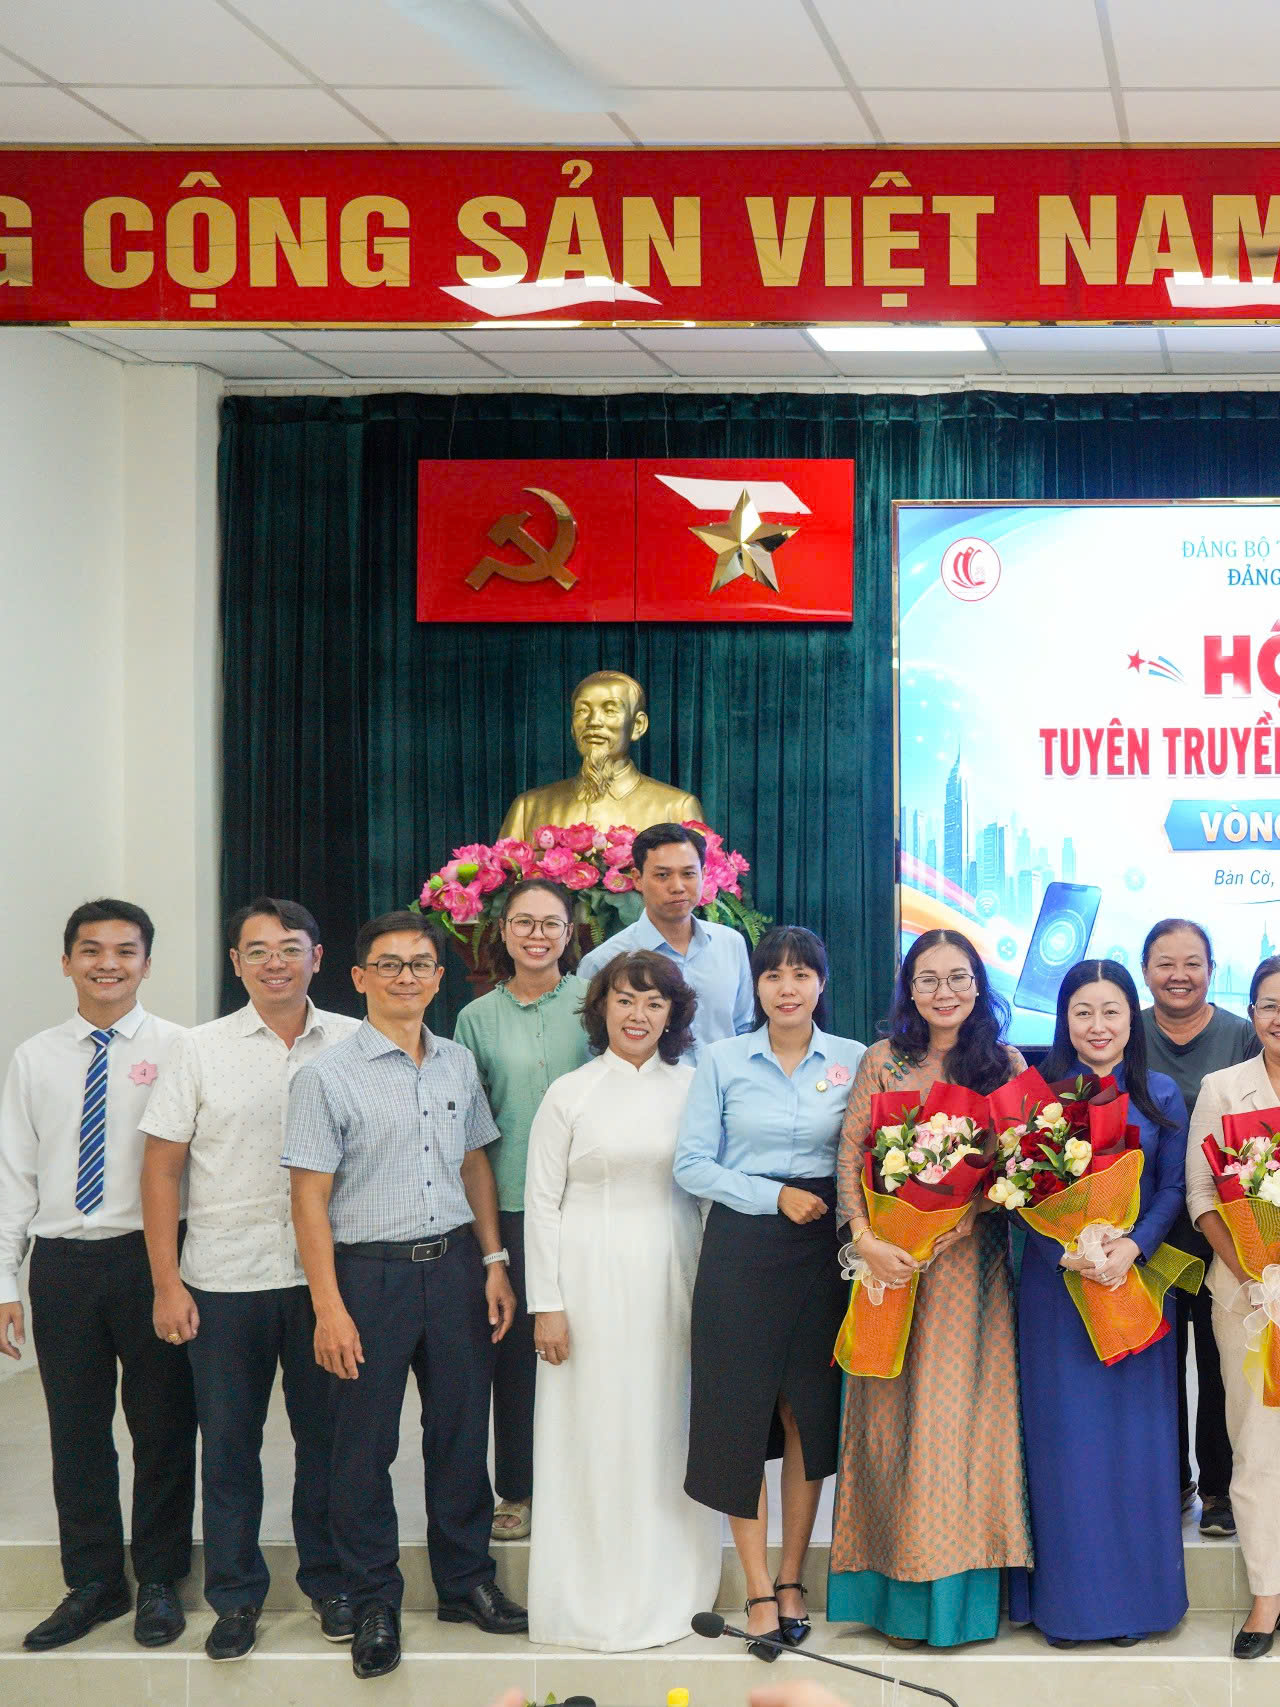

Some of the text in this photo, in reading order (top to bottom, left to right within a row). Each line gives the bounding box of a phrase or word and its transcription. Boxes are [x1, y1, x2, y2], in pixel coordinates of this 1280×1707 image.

[83, 171, 410, 308] CỘNG
[455, 159, 702, 288] SẢN
[745, 171, 995, 307] VIỆT
[1181, 536, 1237, 558] ĐẢNG
[1244, 536, 1270, 561] BỘ
[1040, 718, 1150, 776] TUYÊN
[1214, 869, 1244, 885] Bàn
[1250, 869, 1275, 888] Cờ,
